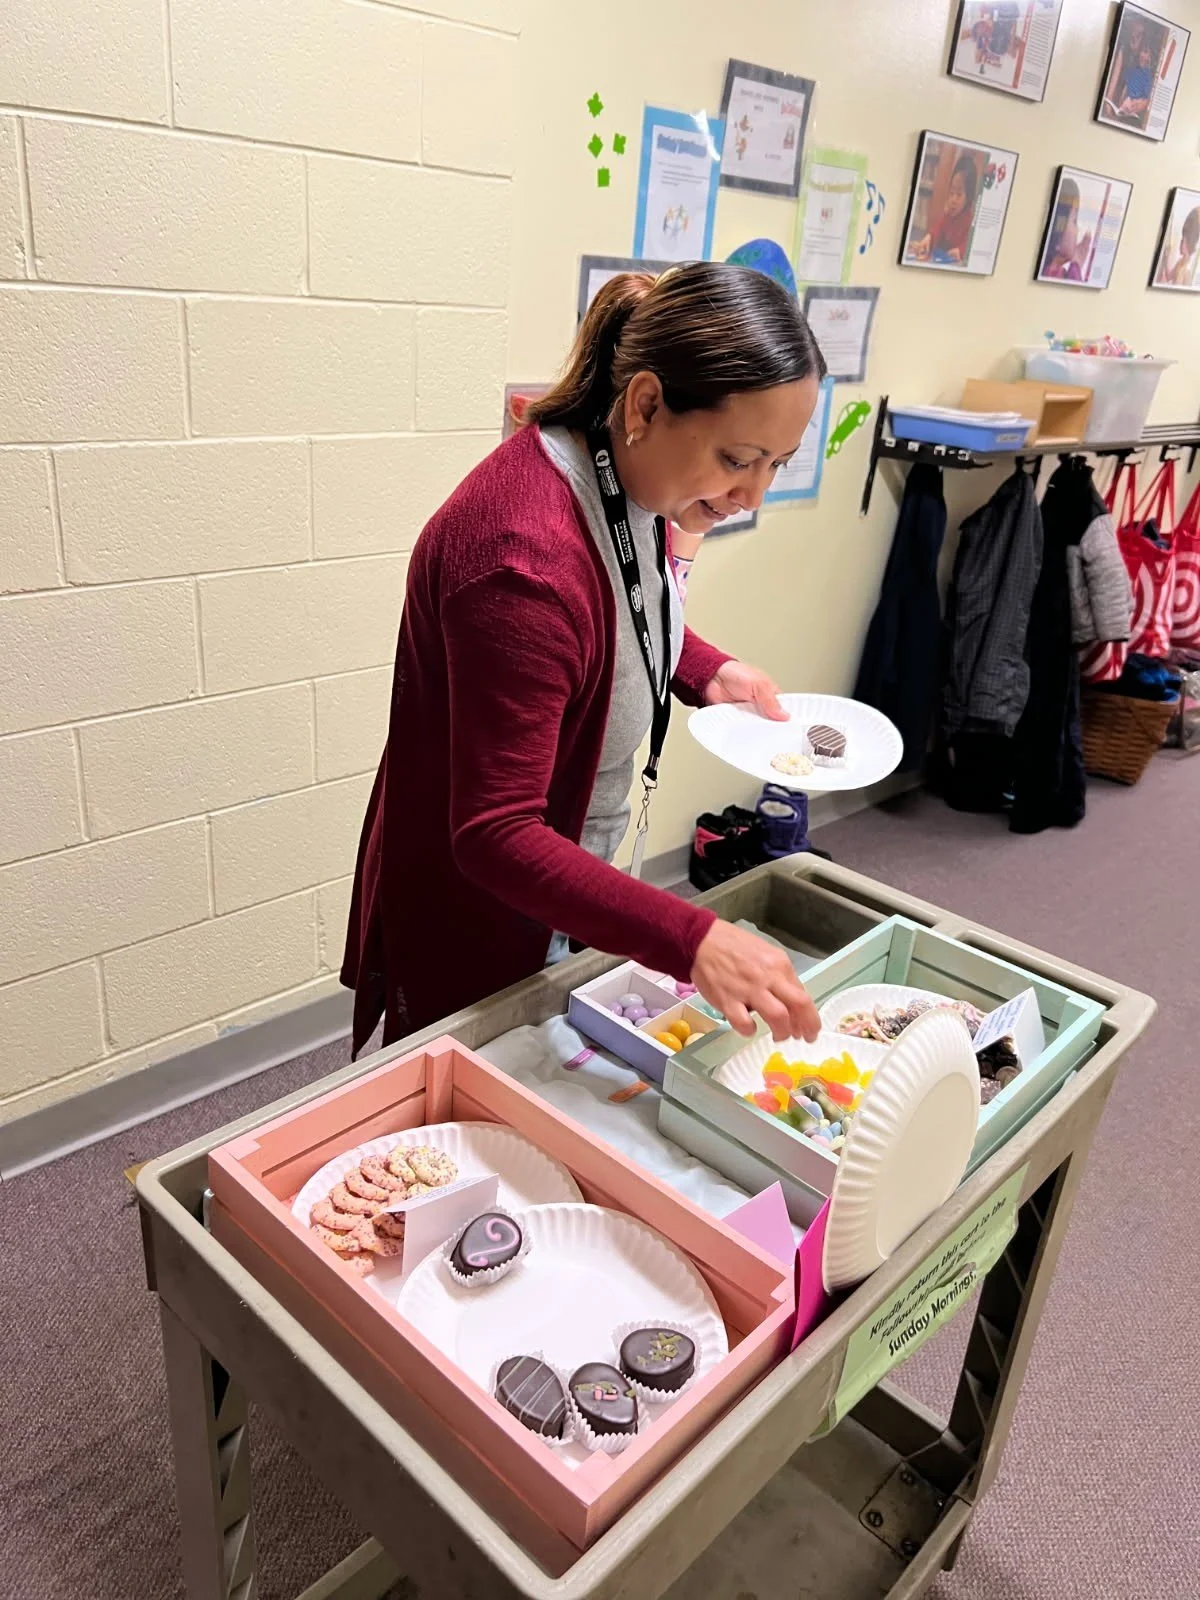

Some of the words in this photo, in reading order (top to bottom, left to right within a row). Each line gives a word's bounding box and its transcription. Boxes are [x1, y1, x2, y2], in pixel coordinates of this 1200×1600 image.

[869, 1298, 905, 1340] Kindly
[907, 1264, 939, 1301] return
[941, 1244, 959, 1267] this
[960, 1223, 979, 1247] cart
[980, 1214, 990, 1227] to
[991, 1198, 1006, 1216] the
[888, 1312, 930, 1357] Sunday
[930, 1271, 977, 1319] Mornings.
